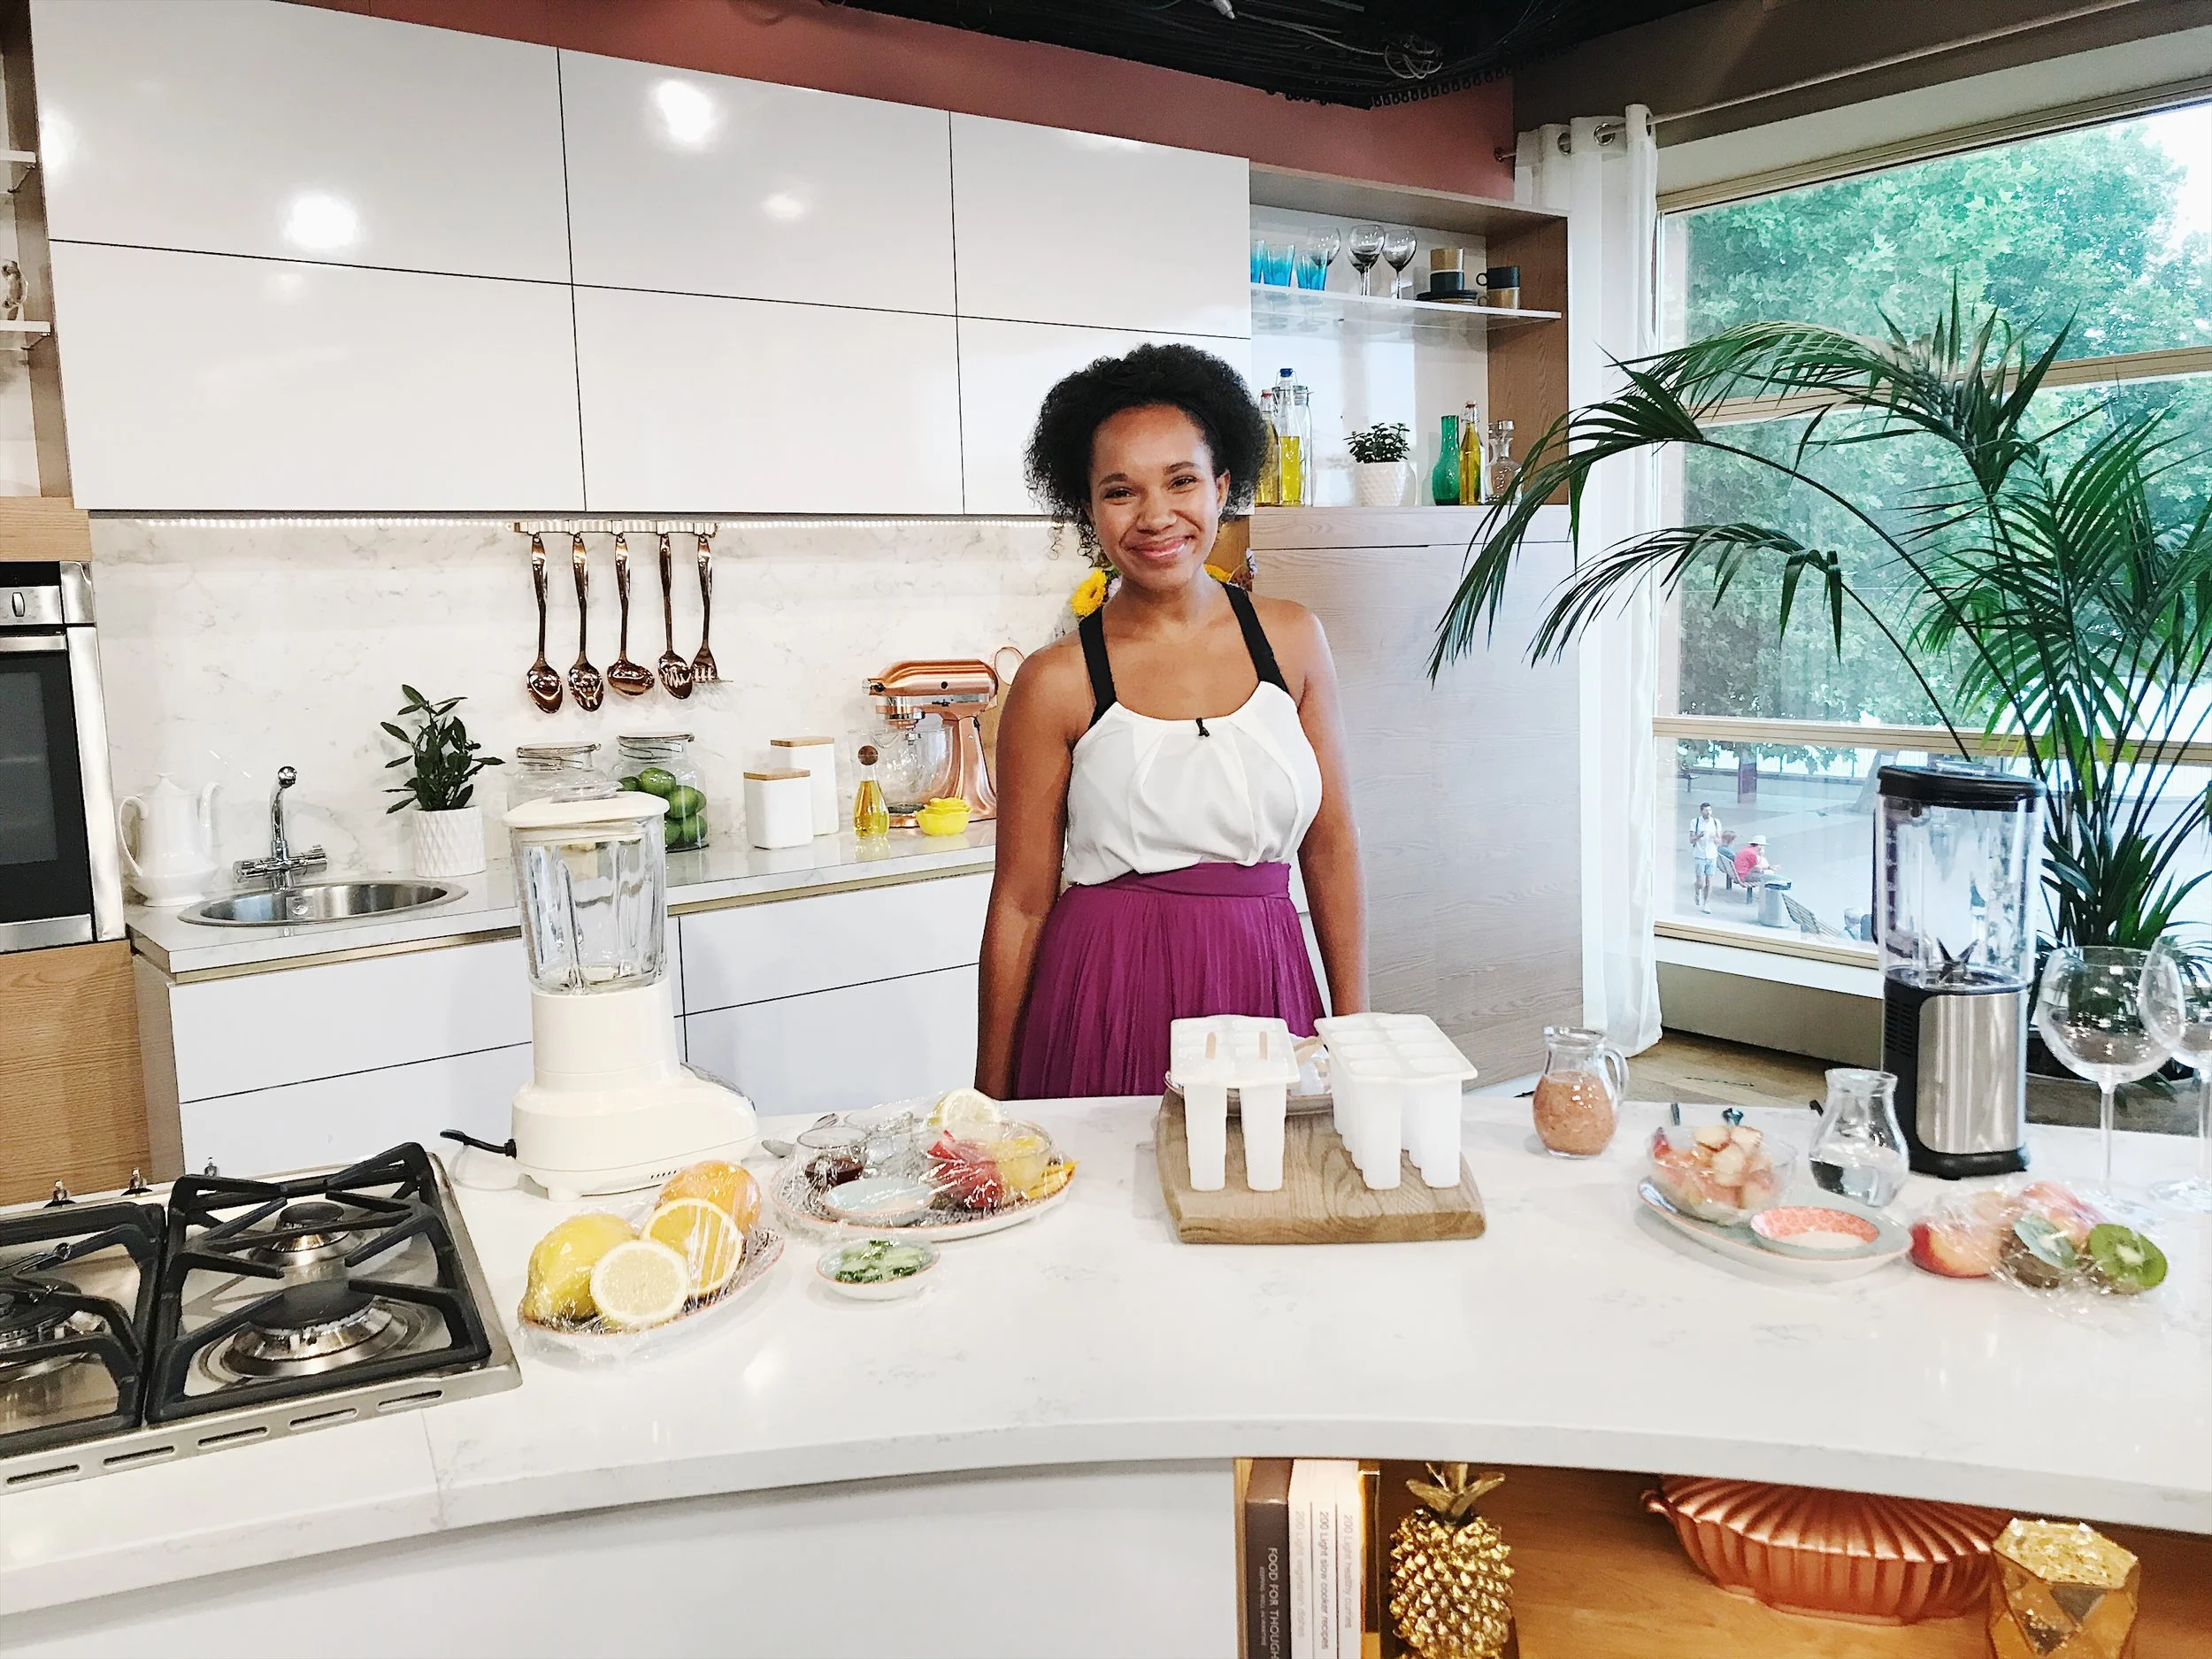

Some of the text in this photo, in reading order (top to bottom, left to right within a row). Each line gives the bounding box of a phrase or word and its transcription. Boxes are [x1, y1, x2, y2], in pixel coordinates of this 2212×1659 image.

[1295, 1510, 1304, 1530] 200
[1319, 1511, 1328, 1530] 200
[1317, 1532, 1328, 1555] Light
[1268, 1548, 1279, 1581] FOOD
[1342, 1515, 1353, 1628] 200 Light healthy curries
[1269, 1584, 1279, 1606] FOR
[1319, 1616, 1329, 1649] recipes
